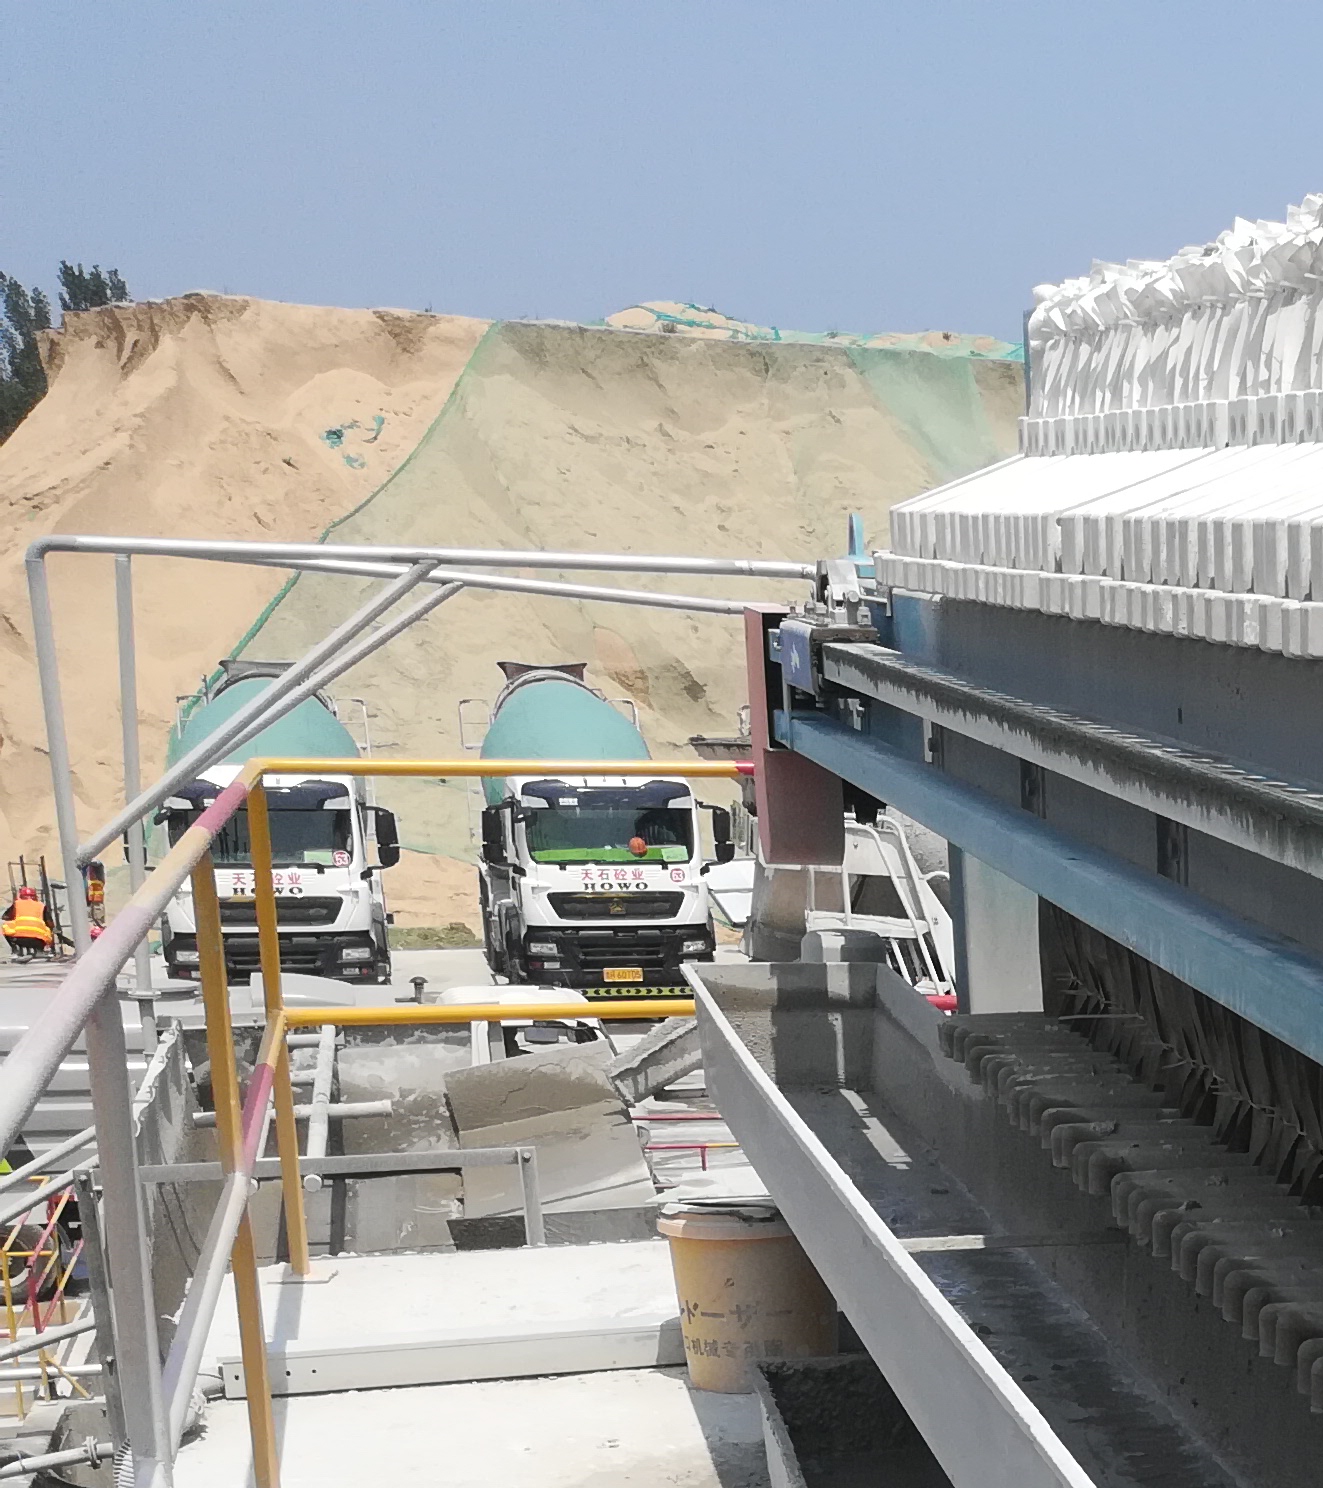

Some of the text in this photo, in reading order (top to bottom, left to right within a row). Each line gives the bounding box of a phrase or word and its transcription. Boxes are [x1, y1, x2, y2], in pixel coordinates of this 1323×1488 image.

[581, 868, 645, 881] 天石砼业
[583, 882, 649, 891] HOWO
